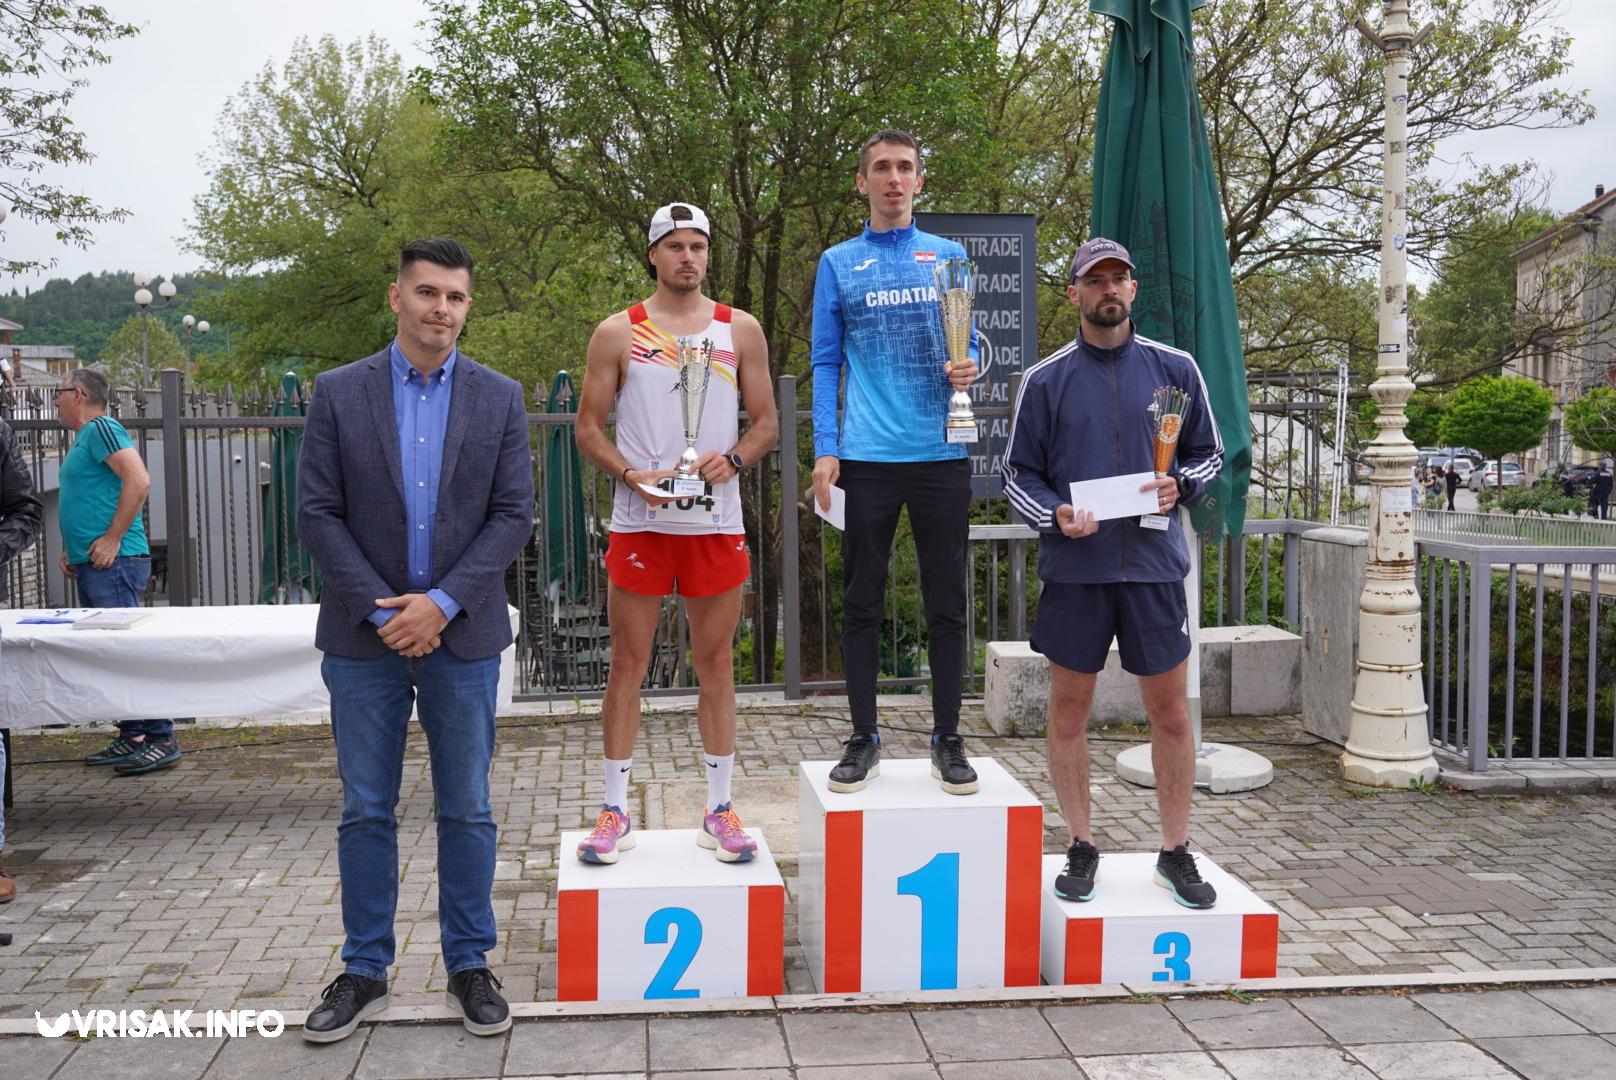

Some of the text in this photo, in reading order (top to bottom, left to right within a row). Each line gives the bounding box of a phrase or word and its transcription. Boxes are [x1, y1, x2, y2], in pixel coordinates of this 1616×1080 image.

[865, 286, 938, 308] CROATIA
[643, 906, 703, 1000] 2
[897, 852, 960, 991] 1
[1152, 931, 1191, 982] 3
